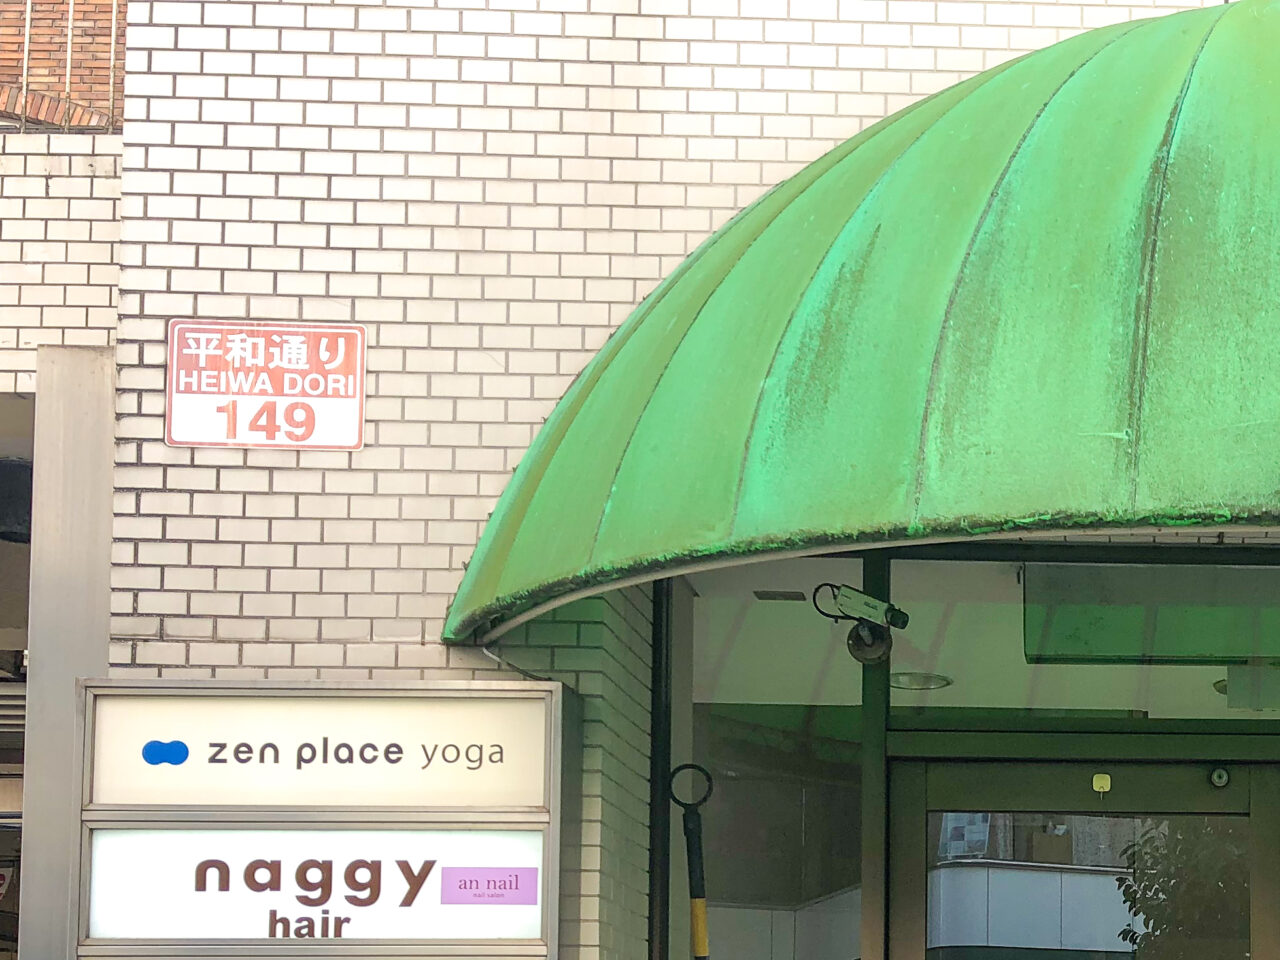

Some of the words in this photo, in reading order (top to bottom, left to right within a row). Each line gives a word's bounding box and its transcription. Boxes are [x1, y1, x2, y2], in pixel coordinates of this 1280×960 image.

[182, 332, 346, 370] 平和通り
[179, 369, 274, 394] HEIWA
[283, 372, 354, 396] DORI
[216, 400, 316, 442] 149
[208, 740, 280, 764] zen
[297, 737, 404, 770] place
[421, 741, 505, 771] yoga
[194, 858, 437, 907] naggy
[458, 878, 480, 890] an
[486, 874, 520, 890] nail
[268, 909, 352, 938] hair
